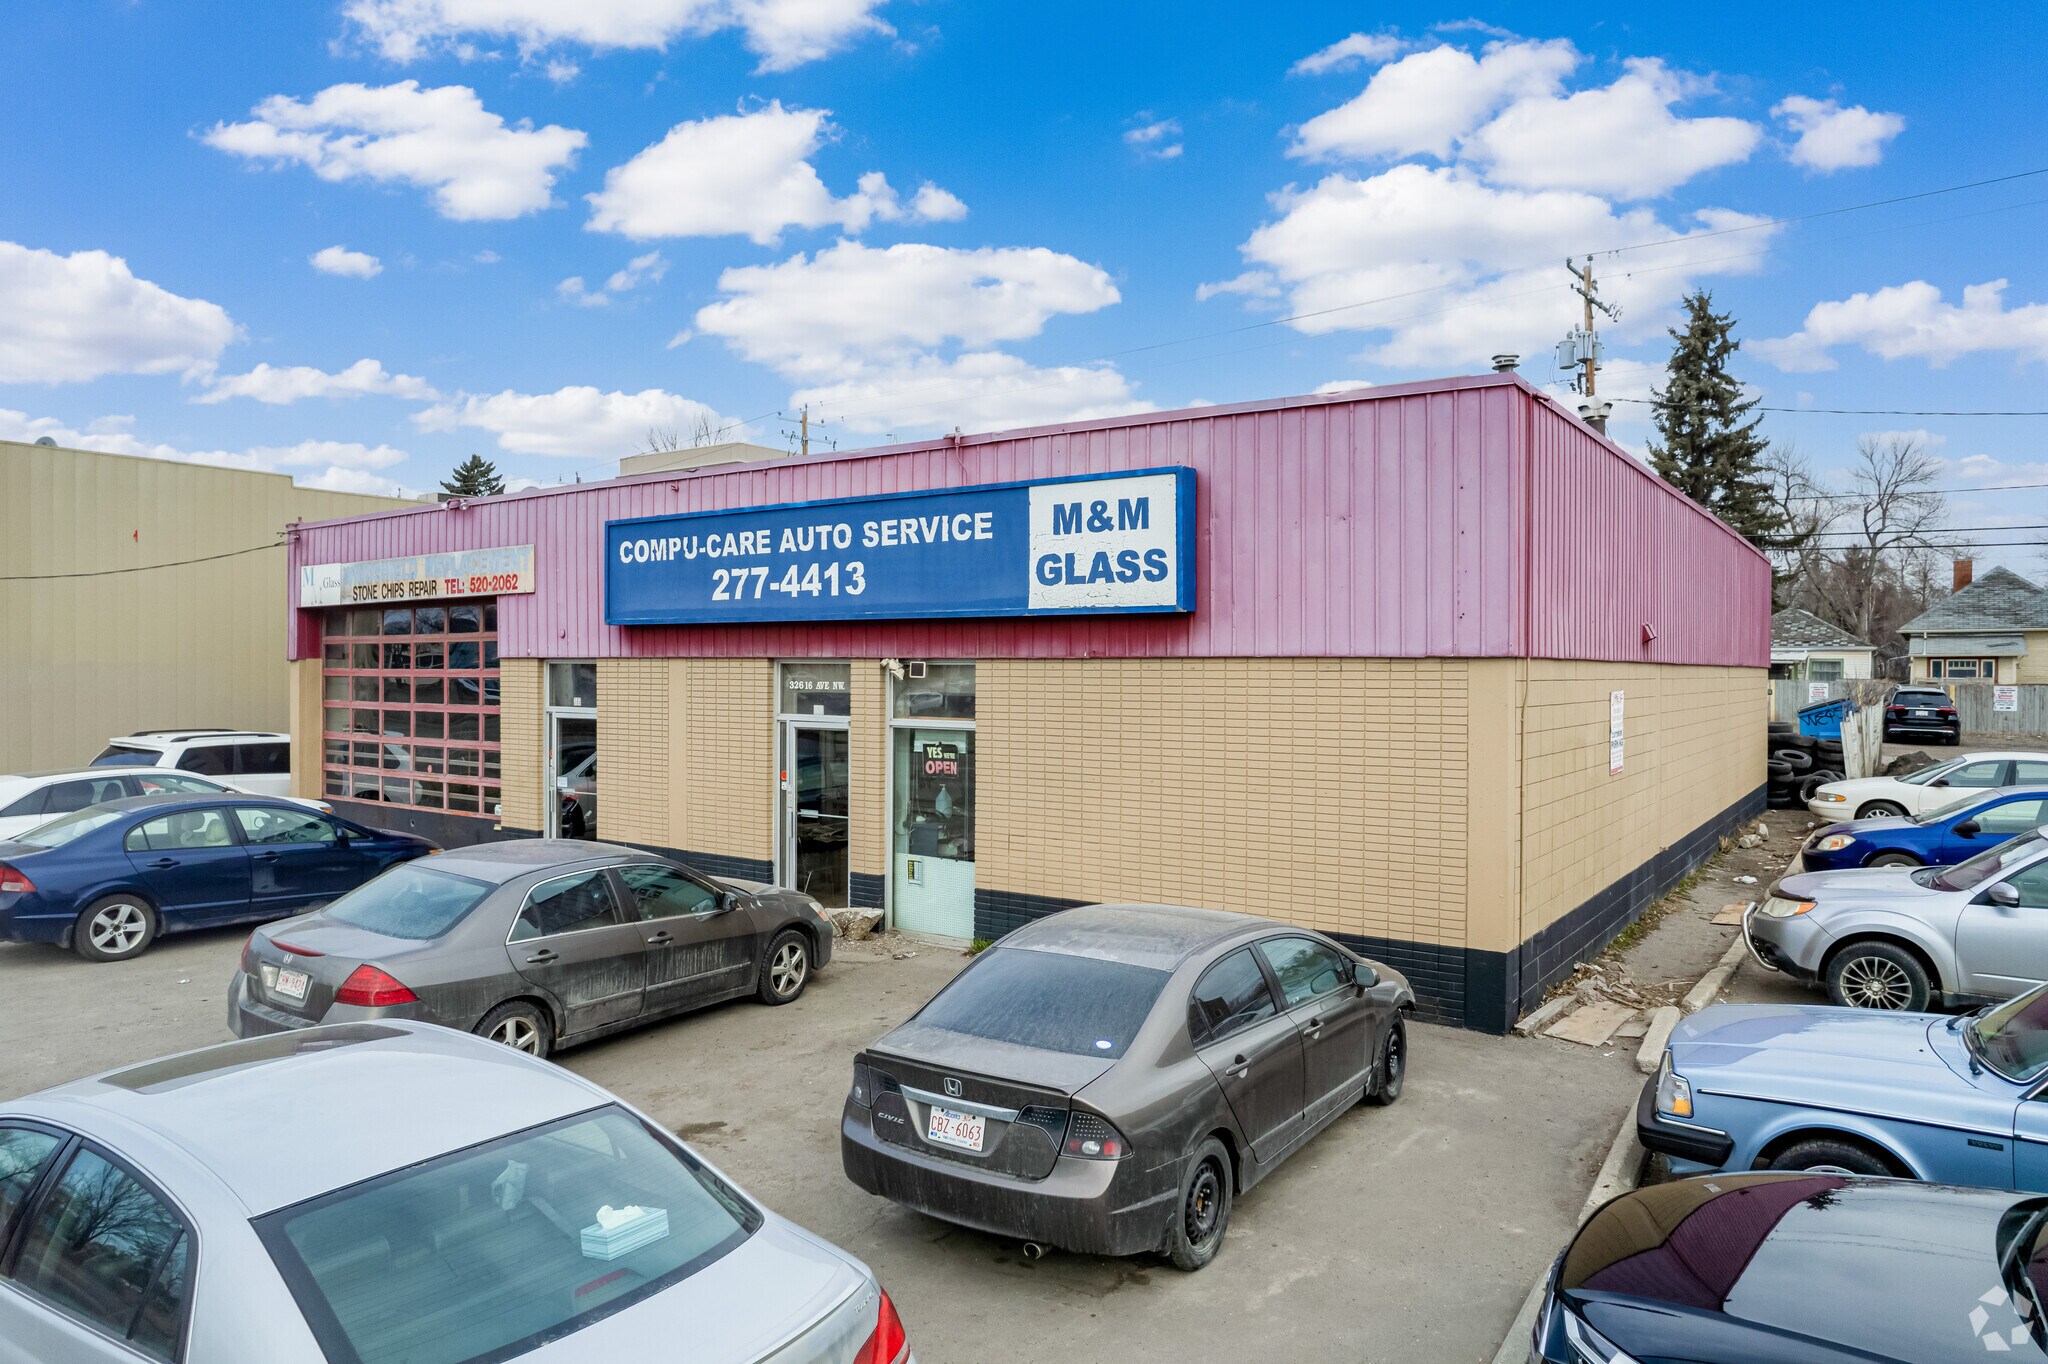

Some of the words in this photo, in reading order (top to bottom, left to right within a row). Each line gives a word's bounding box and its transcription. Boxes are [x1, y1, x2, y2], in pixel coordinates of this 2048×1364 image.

[1053, 497, 1149, 535] M&M
[619, 529, 772, 563] COMPU-CARE
[778, 523, 852, 553] AUTO
[862, 511, 993, 547] SERVICE
[1036, 548, 1168, 586] GLASS
[352, 585, 378, 601] STONE
[381, 582, 404, 599] CHIPS
[408, 579, 437, 597] REPAIR
[444, 579, 465, 595] TEL:
[469, 573, 519, 593] 520-2062
[712, 561, 866, 601] 277-4413
[815, 681, 830, 690] AVE
[926, 746, 943, 759] YES
[925, 760, 957, 775] OPEN
[877, 1112, 905, 1125] CIVIC
[931, 1116, 981, 1141] CBZ-6063
